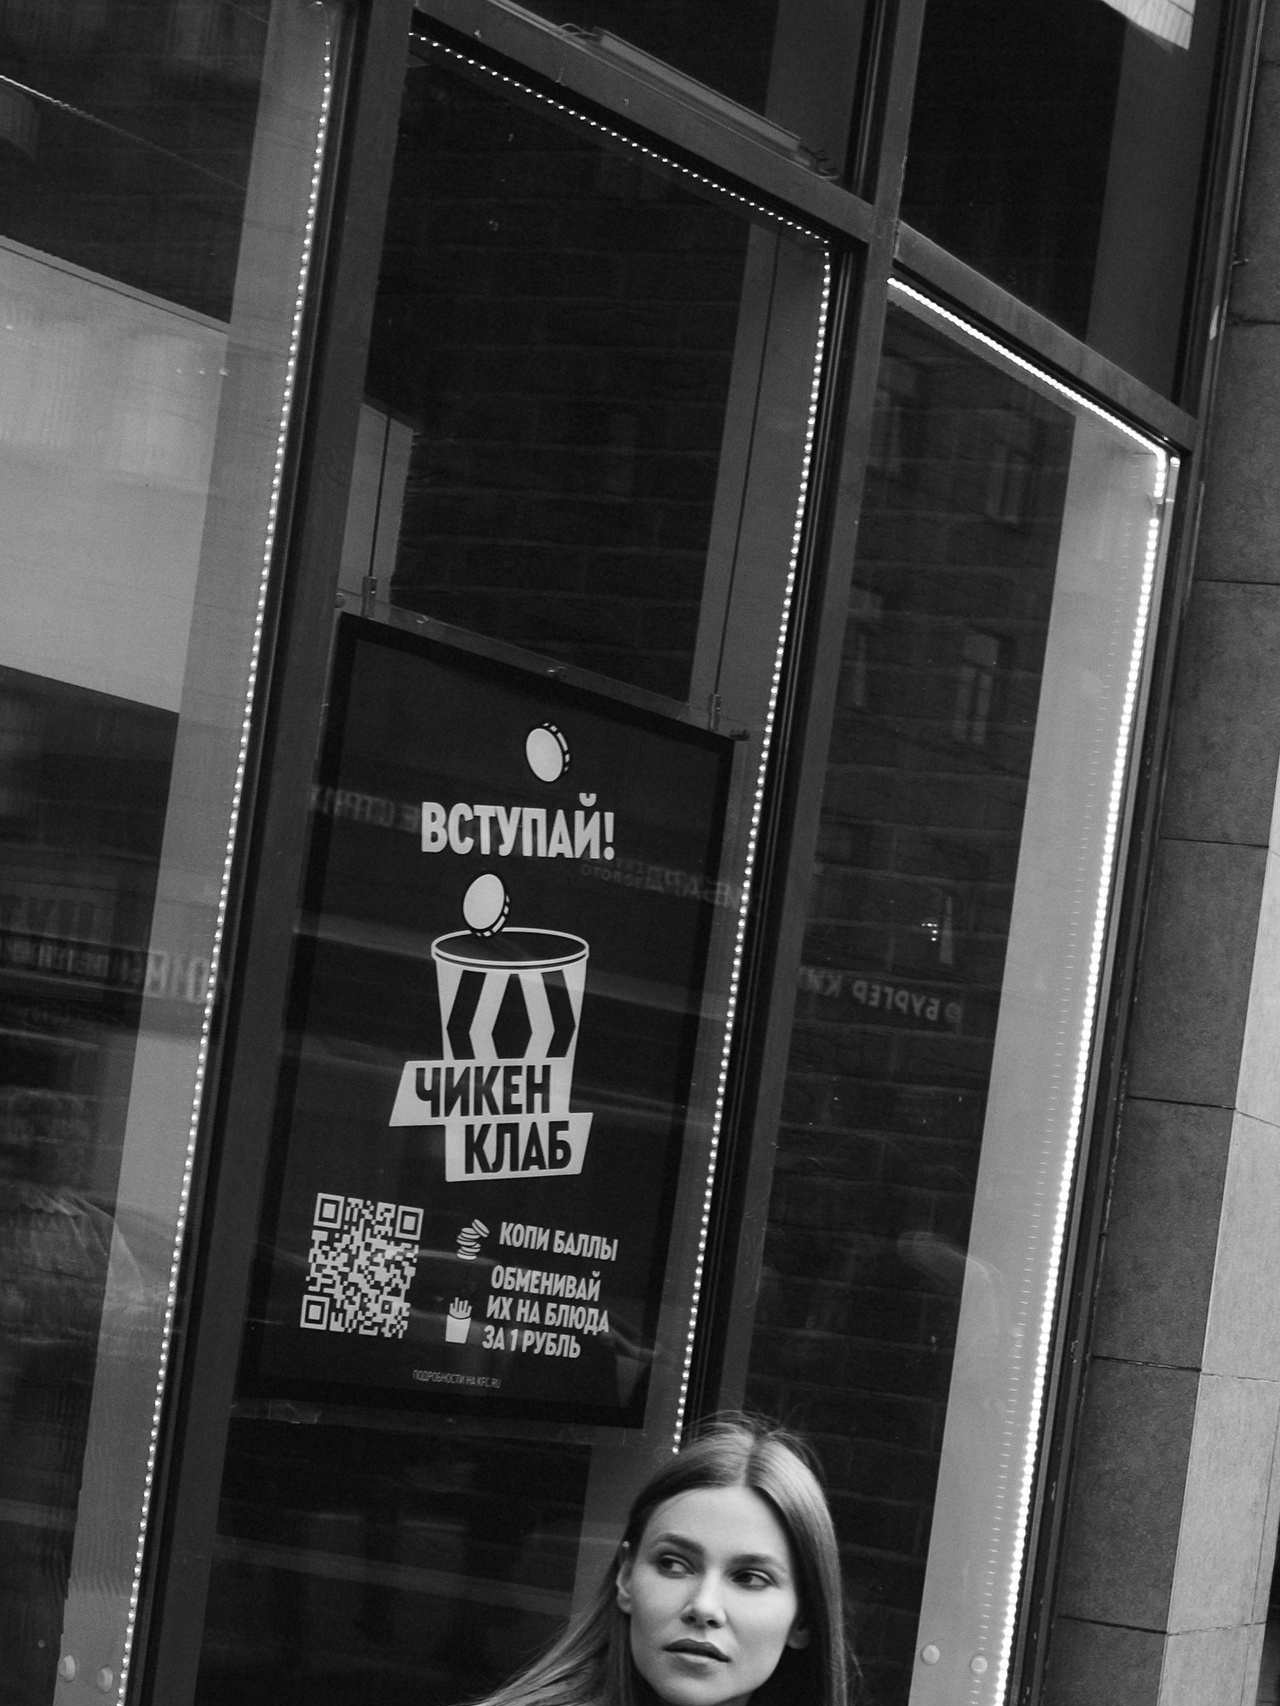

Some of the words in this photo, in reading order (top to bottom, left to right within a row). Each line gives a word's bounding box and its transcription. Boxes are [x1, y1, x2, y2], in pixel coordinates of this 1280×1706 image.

[421, 792, 615, 860] ВСТУПАЙ!
[415, 1064, 552, 1118] ЧИКЕН
[464, 1120, 573, 1175] КЛАБ
[499, 1221, 551, 1252] КОПИ
[553, 1230, 618, 1262] БАЛЛЫ
[491, 1265, 601, 1302] ОБМЕНИВАЙ
[486, 1294, 514, 1321] ИХ
[516, 1299, 540, 1325] НА
[544, 1302, 609, 1336] БЛЮДА
[482, 1325, 505, 1350] ЗА
[510, 1328, 519, 1352] 1
[521, 1329, 581, 1359] РУБЛЬ
